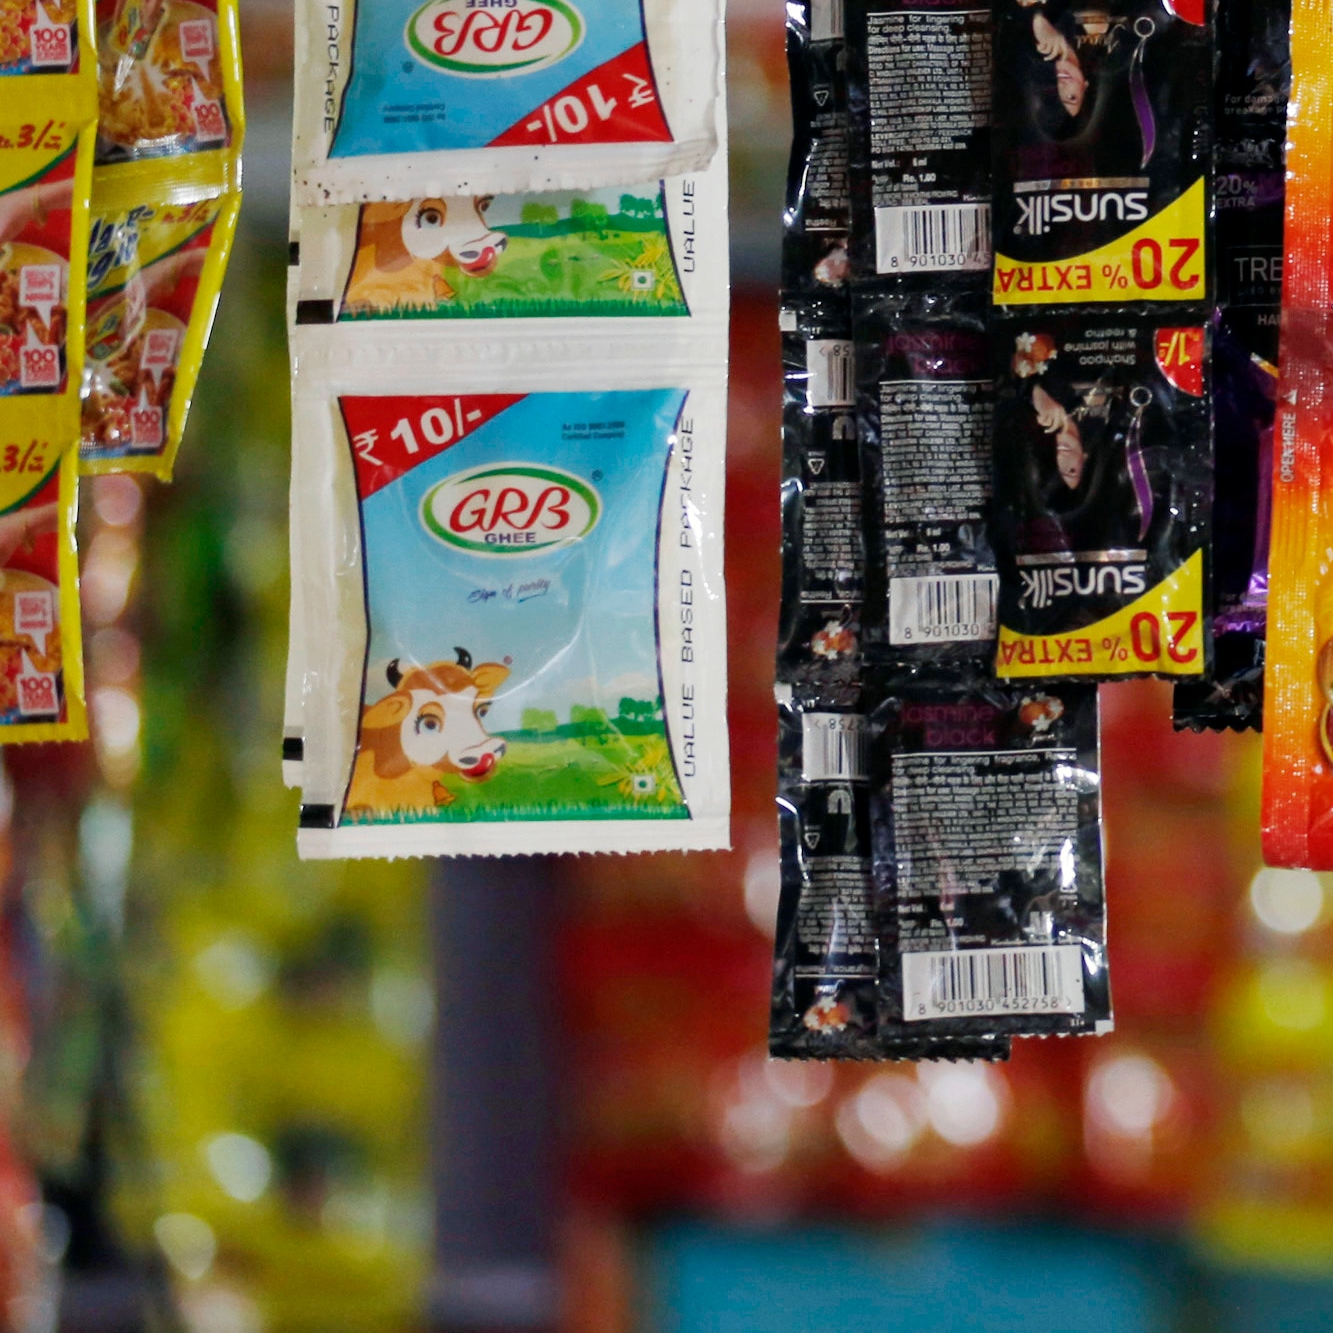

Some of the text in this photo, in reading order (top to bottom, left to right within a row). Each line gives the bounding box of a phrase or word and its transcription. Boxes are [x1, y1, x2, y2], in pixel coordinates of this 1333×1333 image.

[434, 8, 553, 55] GRB
[324, 6, 339, 132] PACKAGE
[1103, 243, 1199, 289] 20%
[680, 418, 694, 548] PACKAGE
[450, 487, 571, 533] GRB
[484, 531, 536, 544] GHEE
[681, 569, 694, 662] BASED
[1103, 611, 1197, 663] 20%
